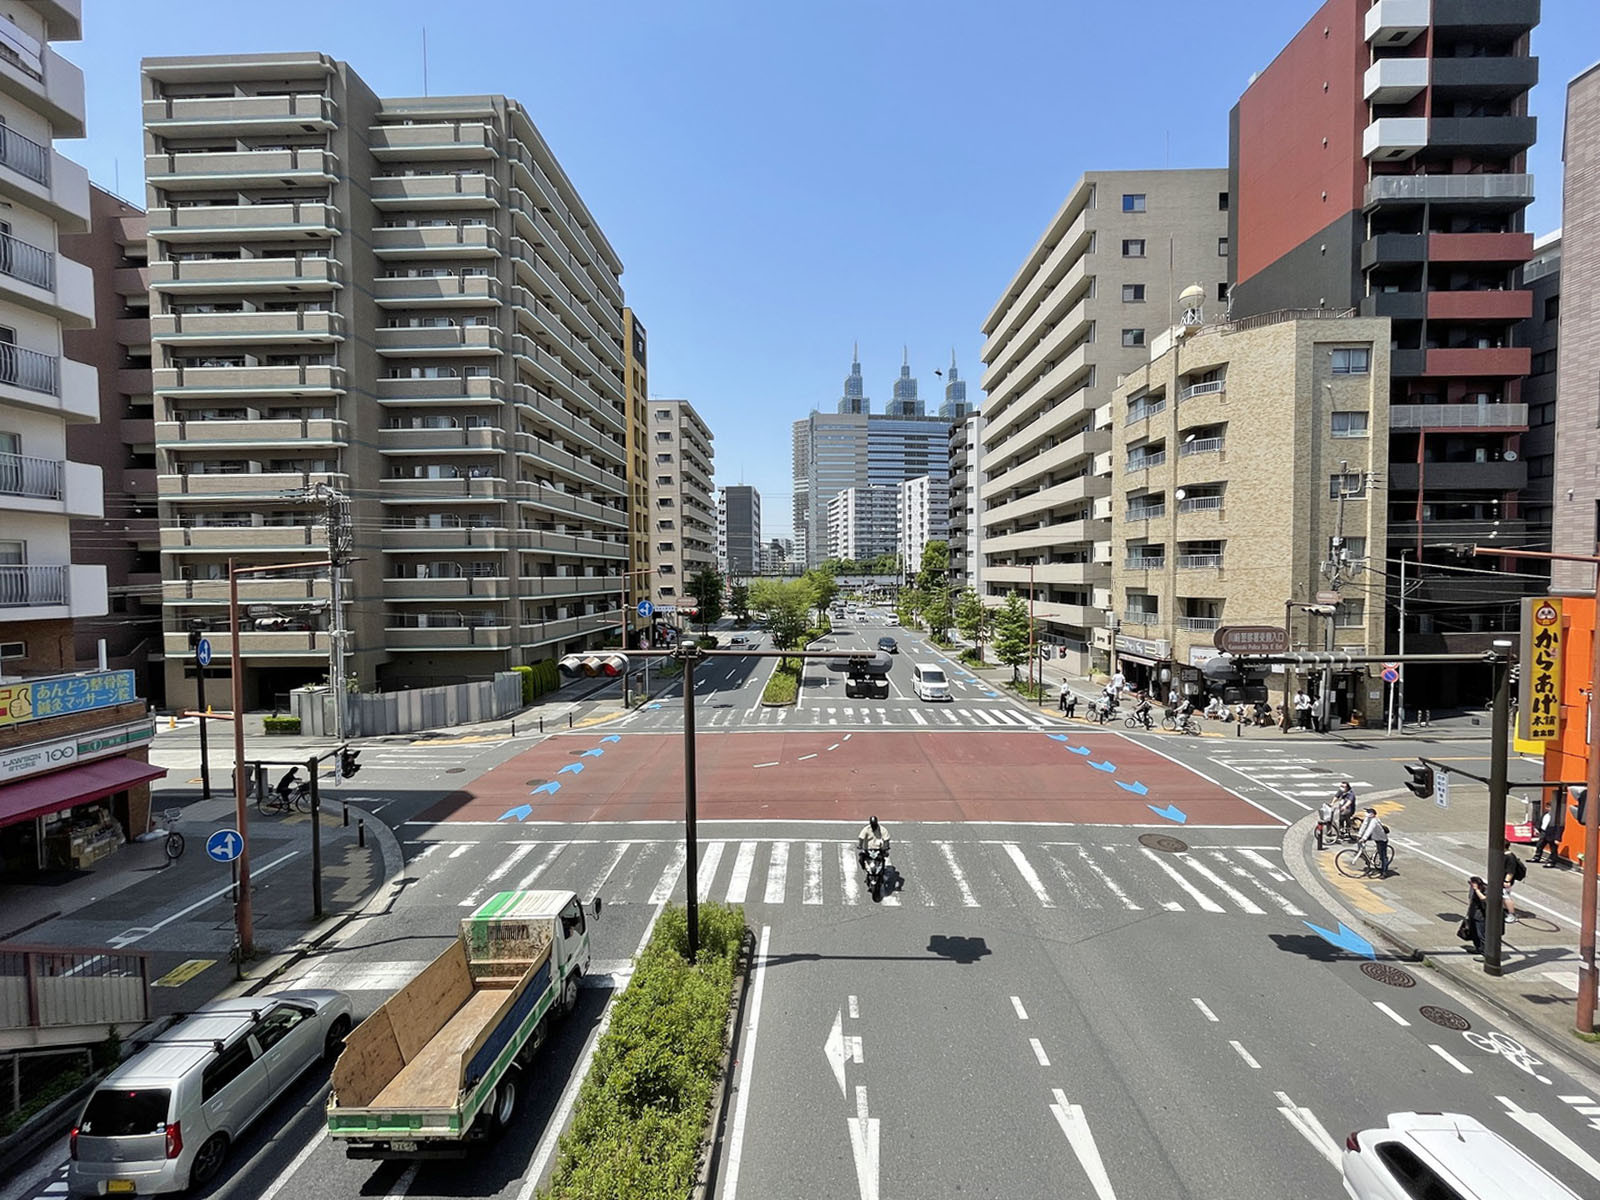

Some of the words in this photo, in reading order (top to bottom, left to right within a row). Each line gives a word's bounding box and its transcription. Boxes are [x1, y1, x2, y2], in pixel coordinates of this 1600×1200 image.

[1533, 628, 1559, 714] からあげ
[36, 674, 130, 698] あんどう整骨院
[2, 753, 41, 768] LAWSON
[45, 746, 74, 762] 100
[8, 761, 36, 772] STORE
